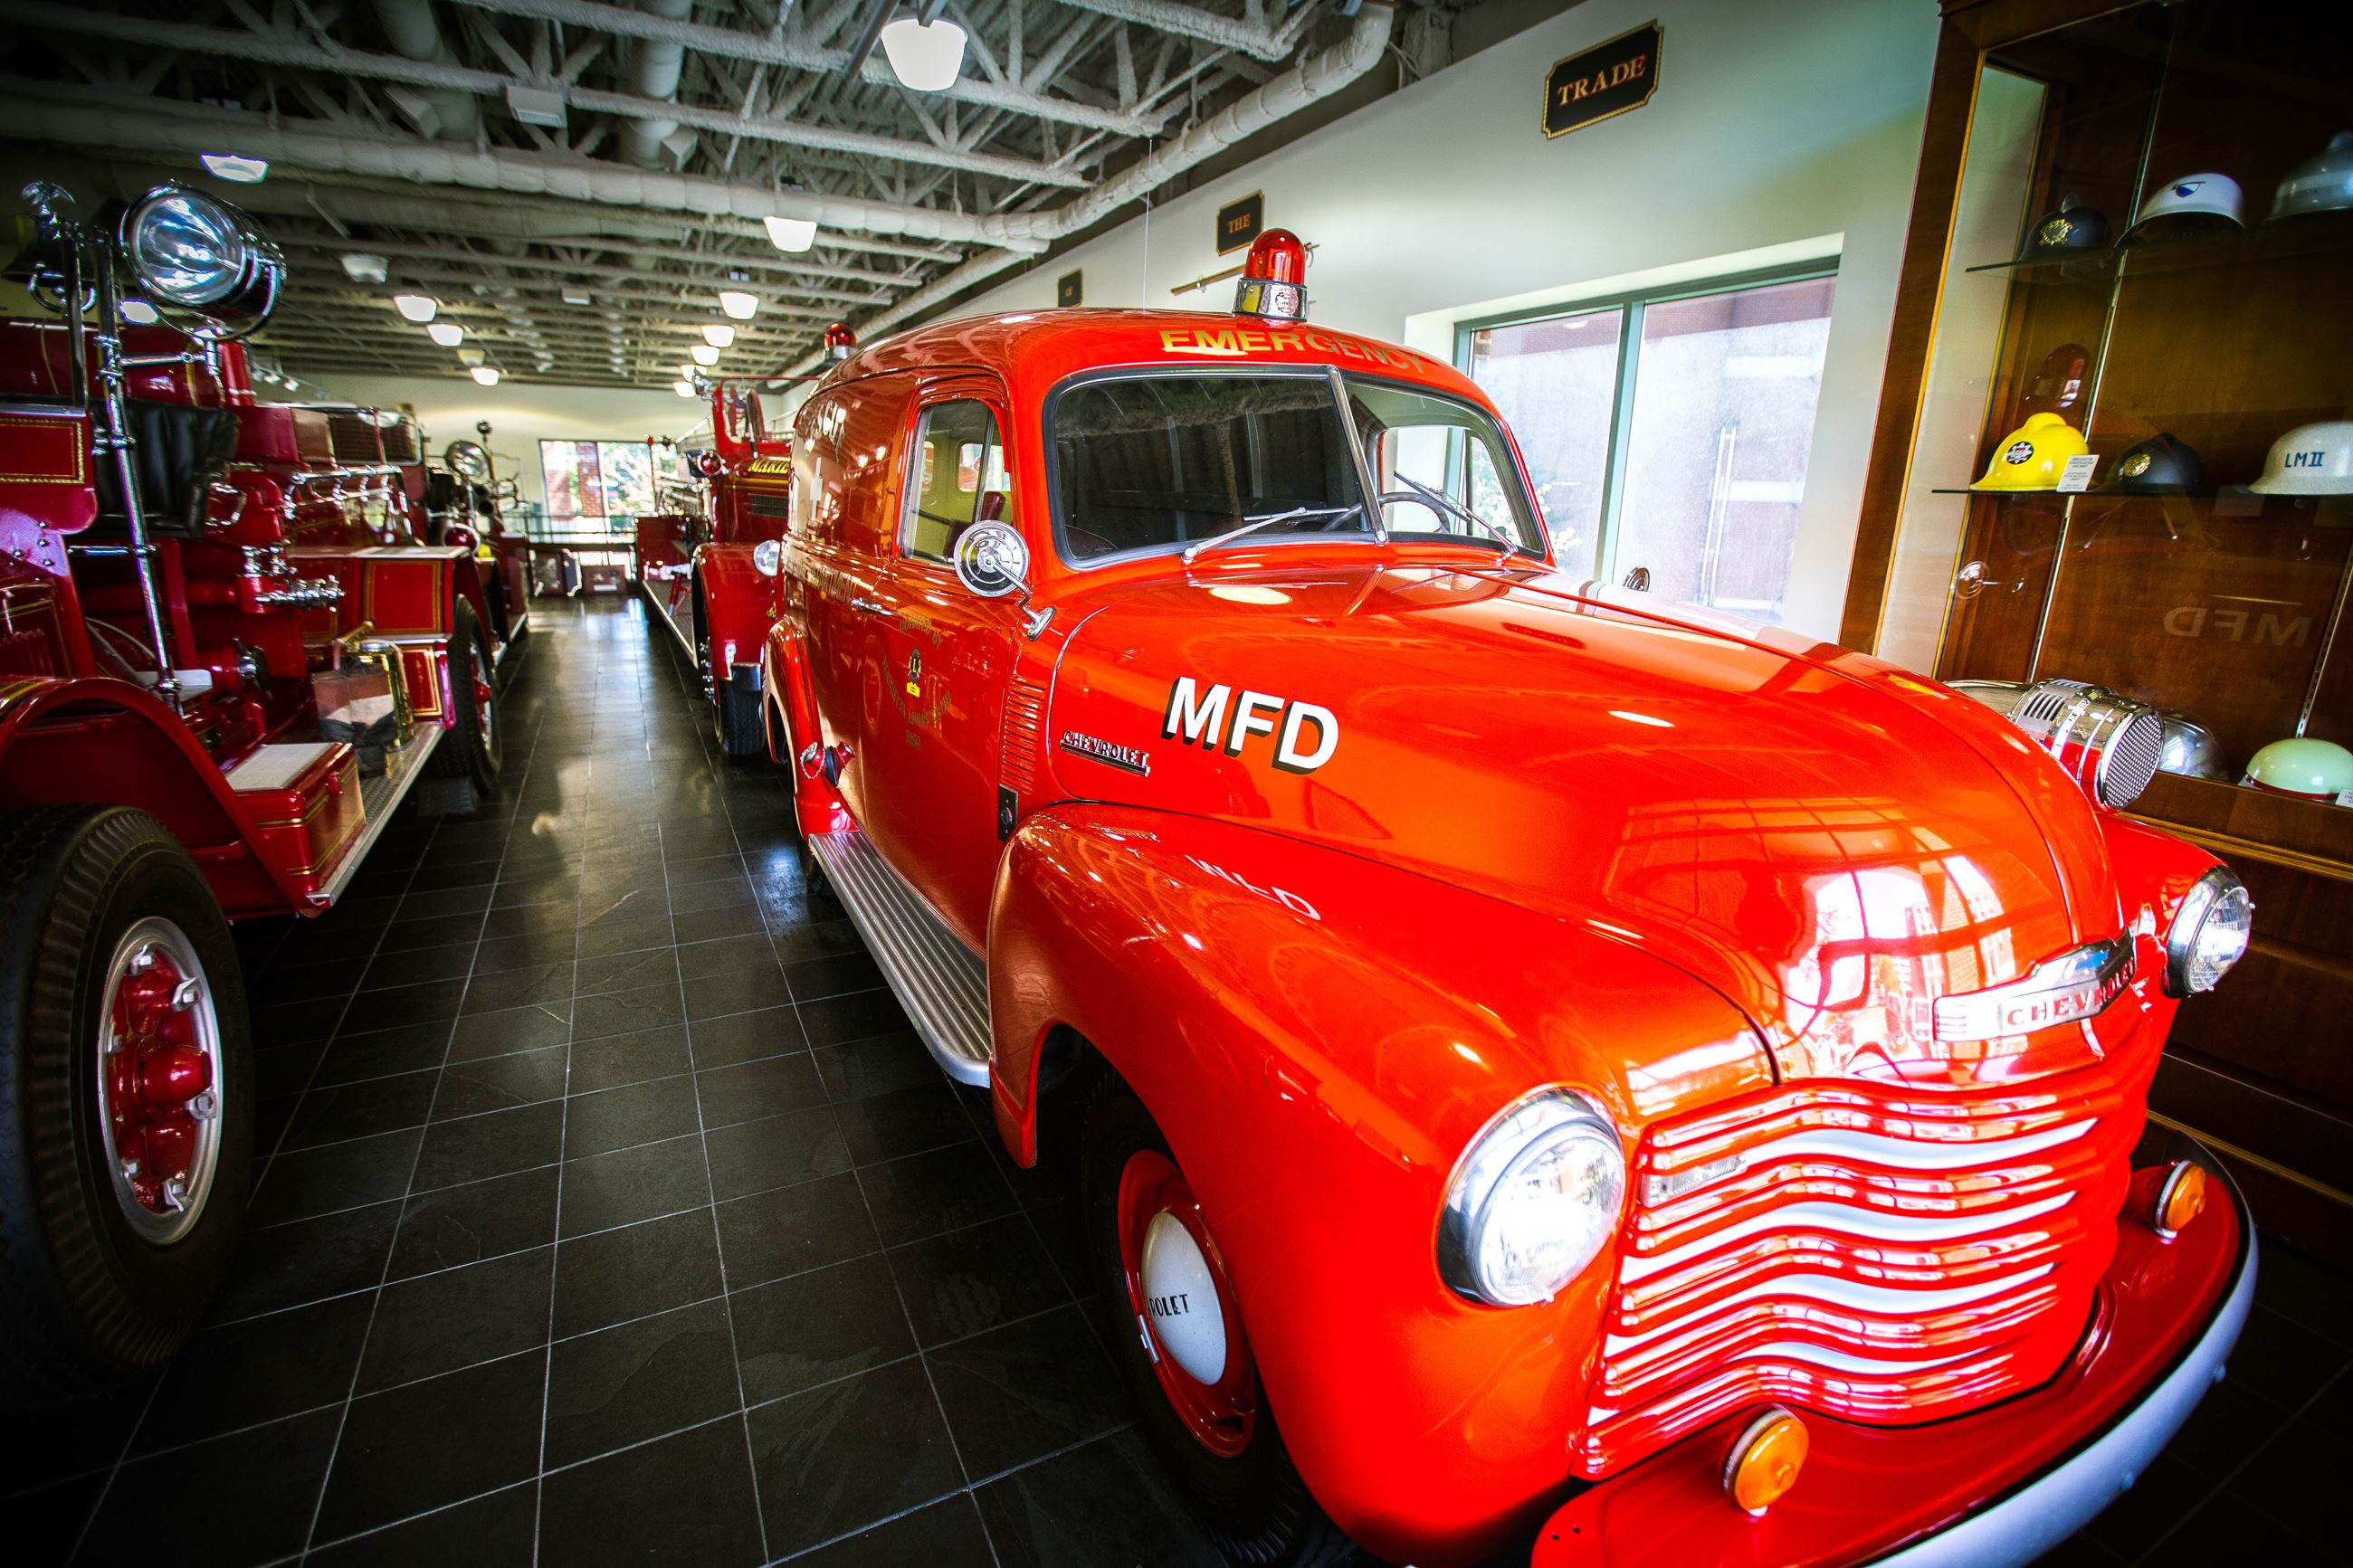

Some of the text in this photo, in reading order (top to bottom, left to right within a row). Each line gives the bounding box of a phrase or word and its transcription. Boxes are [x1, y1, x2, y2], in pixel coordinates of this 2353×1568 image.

[1557, 54, 1647, 107] TRADE
[1228, 214, 1251, 233] THE
[1158, 329, 1425, 374] EMERGENCY
[748, 459, 788, 474] MARIE
[1160, 676, 1339, 775] MFD
[1063, 730, 1150, 770] CHEVROLET
[2006, 956, 2136, 1026] CHEVROLET
[1148, 1294, 1189, 1317] ROLET
